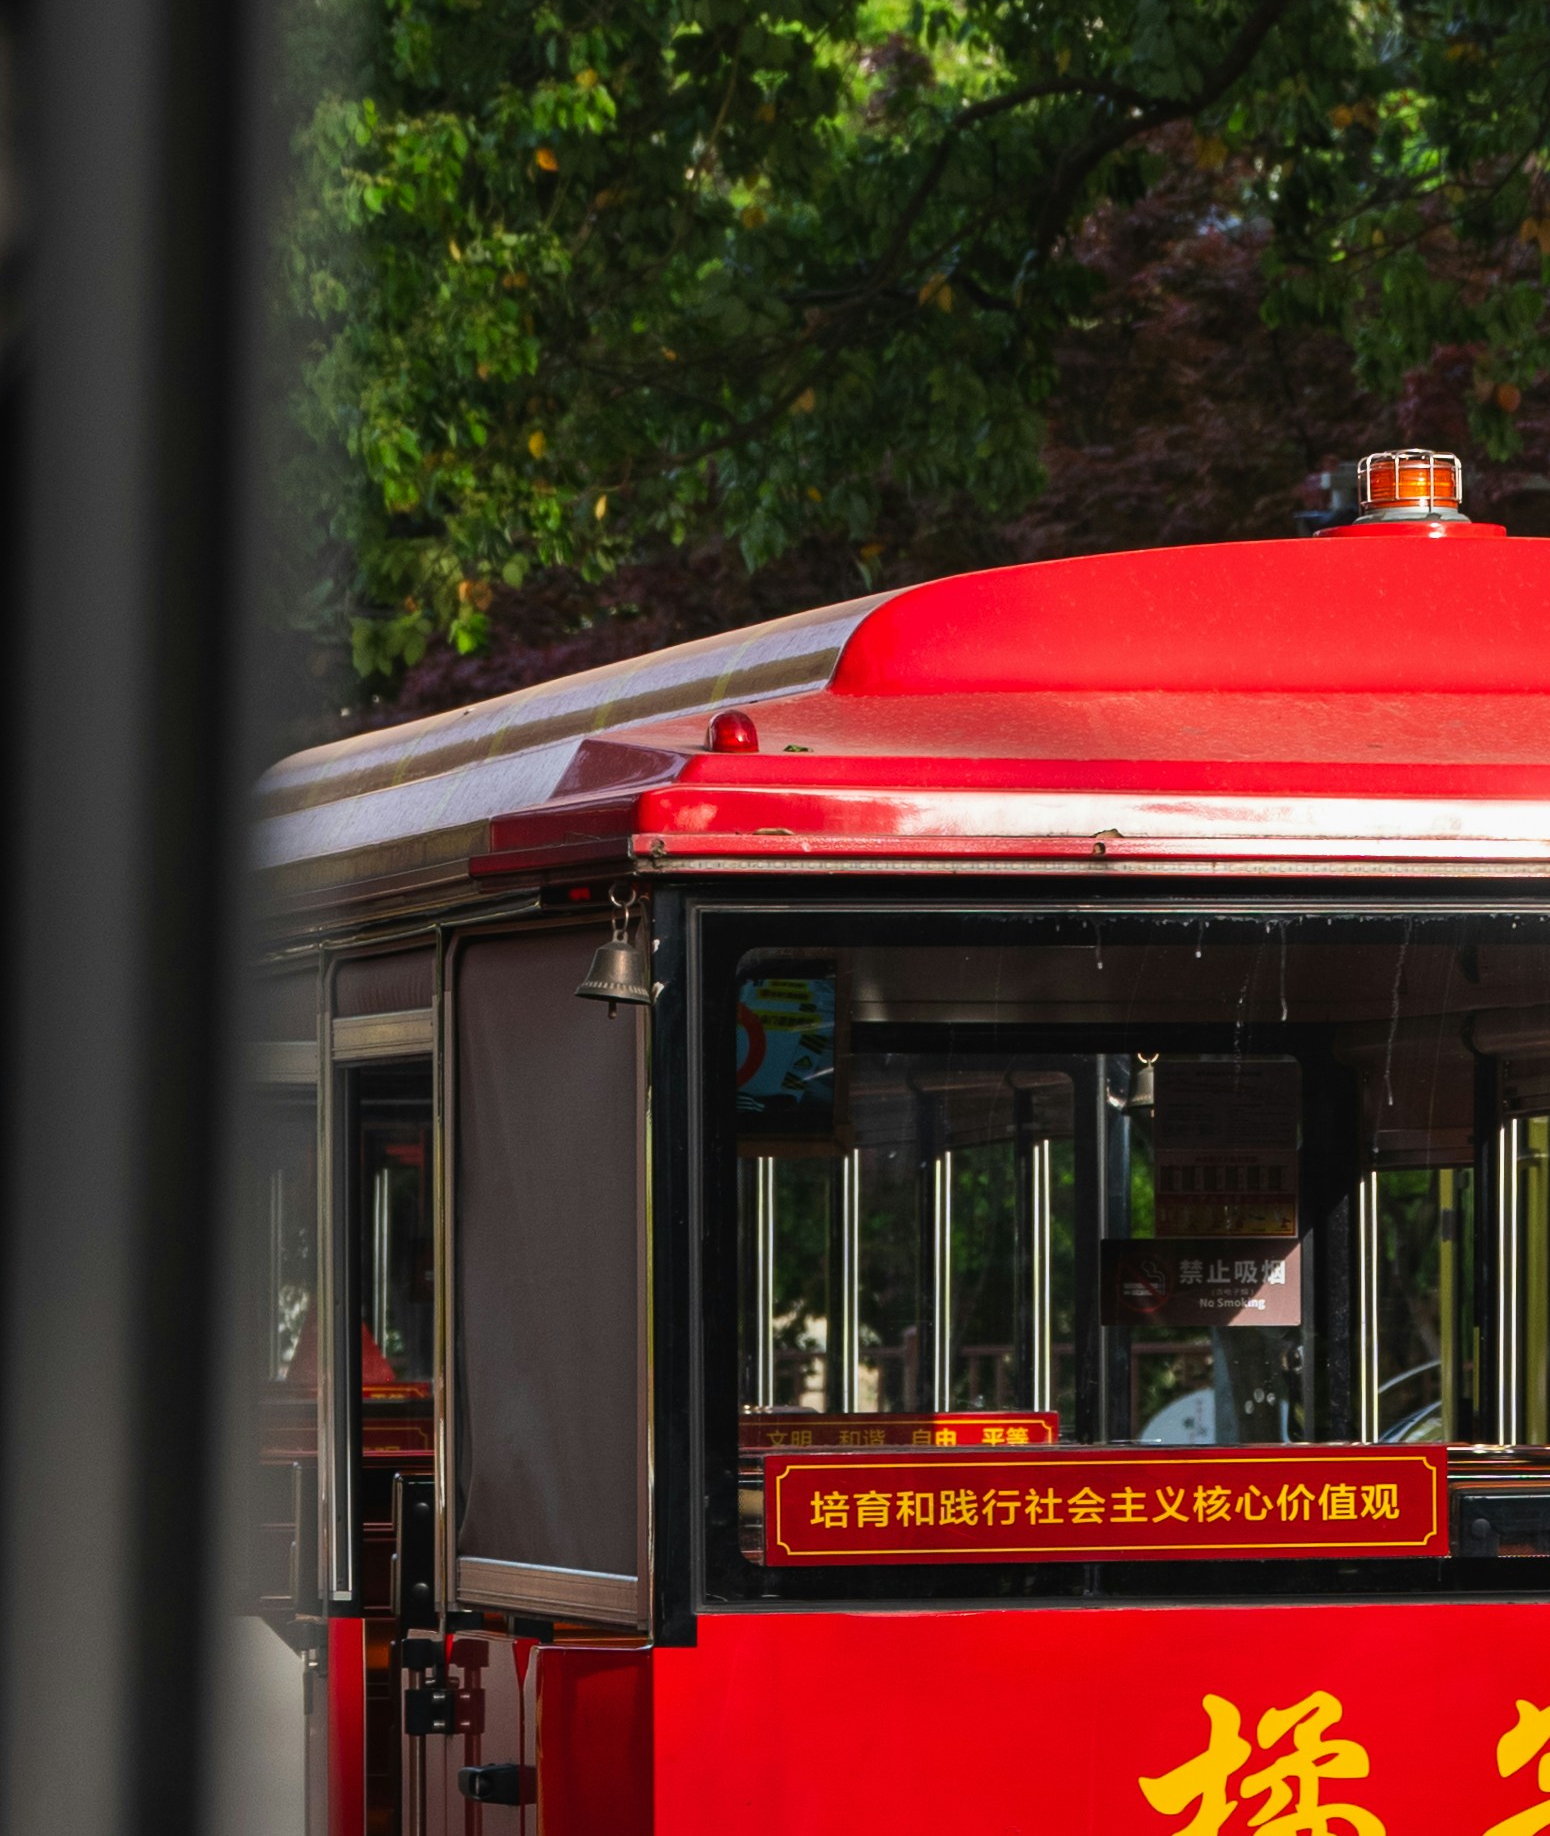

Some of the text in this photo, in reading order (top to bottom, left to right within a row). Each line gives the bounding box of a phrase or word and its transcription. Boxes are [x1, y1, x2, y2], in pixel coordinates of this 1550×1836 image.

[1179, 1259, 1285, 1285] 禁止吸烟
[1200, 1298, 1266, 1310] No Smoking
[811, 1483, 1400, 1529] 培育和践行社会主义核心价值观
